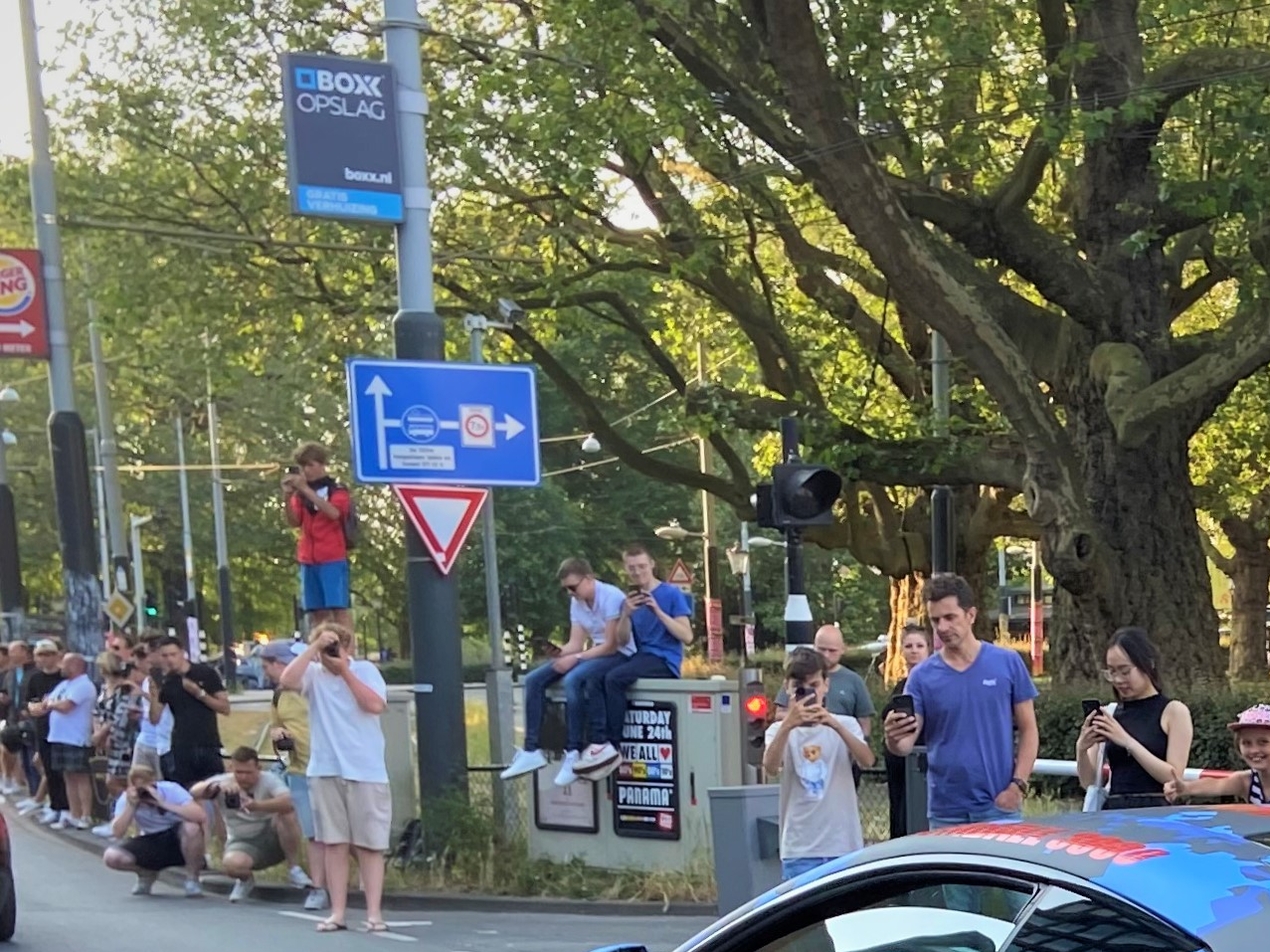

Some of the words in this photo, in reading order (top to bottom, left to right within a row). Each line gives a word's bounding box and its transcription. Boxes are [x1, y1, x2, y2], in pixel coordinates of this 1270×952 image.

[296, 92, 387, 121] OPSLAG
[344, 167, 393, 184] boxx.nl
[624, 709, 672, 725] ATURDAY
[622, 724, 644, 740] UNE
[639, 745, 659, 761] ALL
[618, 786, 670, 806] PANAMA
